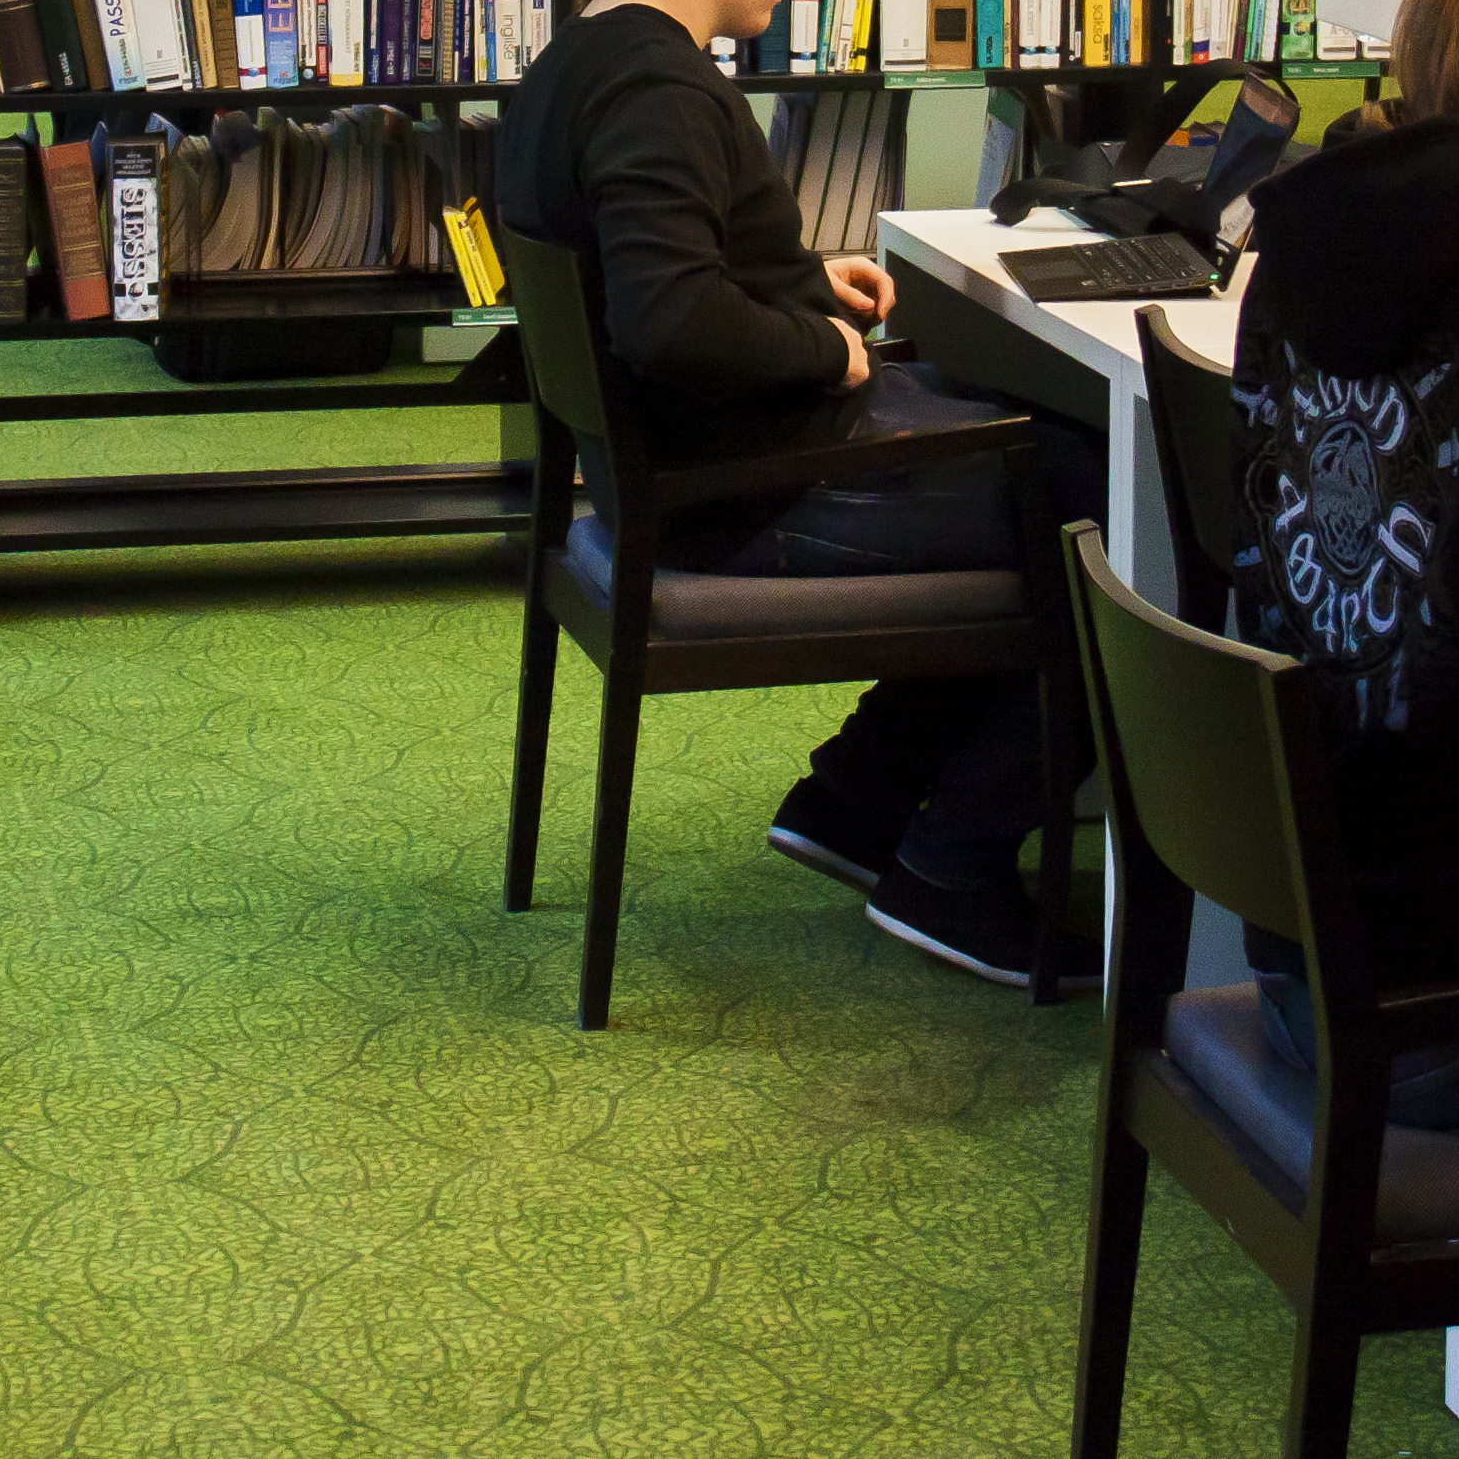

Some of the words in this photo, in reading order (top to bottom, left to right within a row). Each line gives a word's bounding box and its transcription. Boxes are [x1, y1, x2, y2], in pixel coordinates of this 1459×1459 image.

[499, 14, 516, 61] inglise
[1091, 3, 1105, 45] saksa
[120, 187, 148, 281] SIESS
